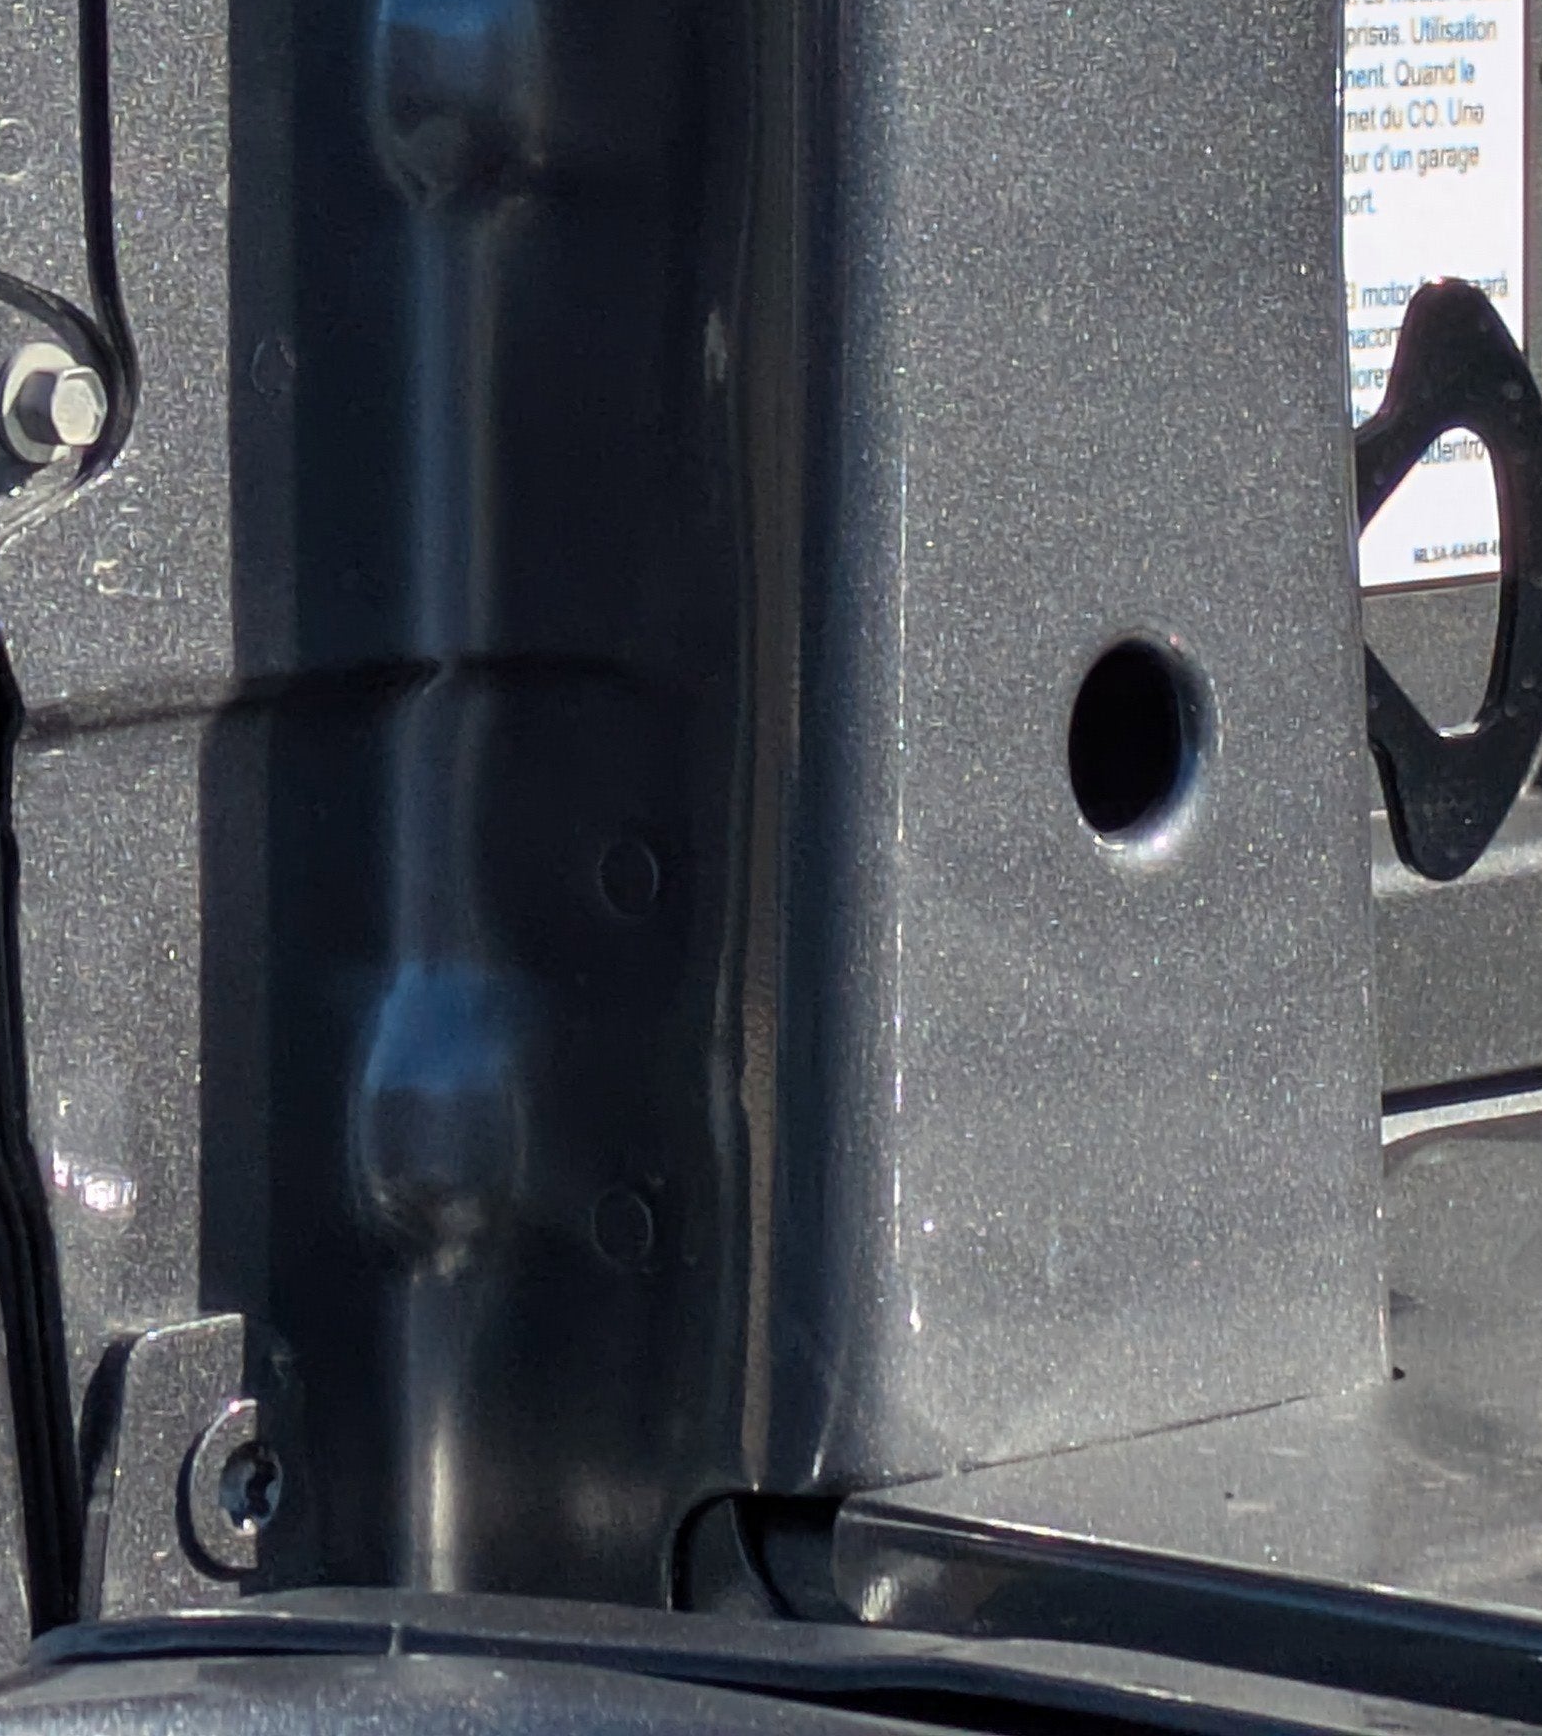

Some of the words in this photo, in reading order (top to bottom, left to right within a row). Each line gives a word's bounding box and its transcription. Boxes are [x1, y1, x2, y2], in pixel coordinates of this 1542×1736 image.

[1410, 13, 1497, 44] Utilisation
[1395, 58, 1456, 87] Quand
[1460, 57, 1475, 83] le
[1380, 104, 1403, 130] du
[1417, 144, 1480, 177] garage
[1362, 279, 1413, 308] motor
